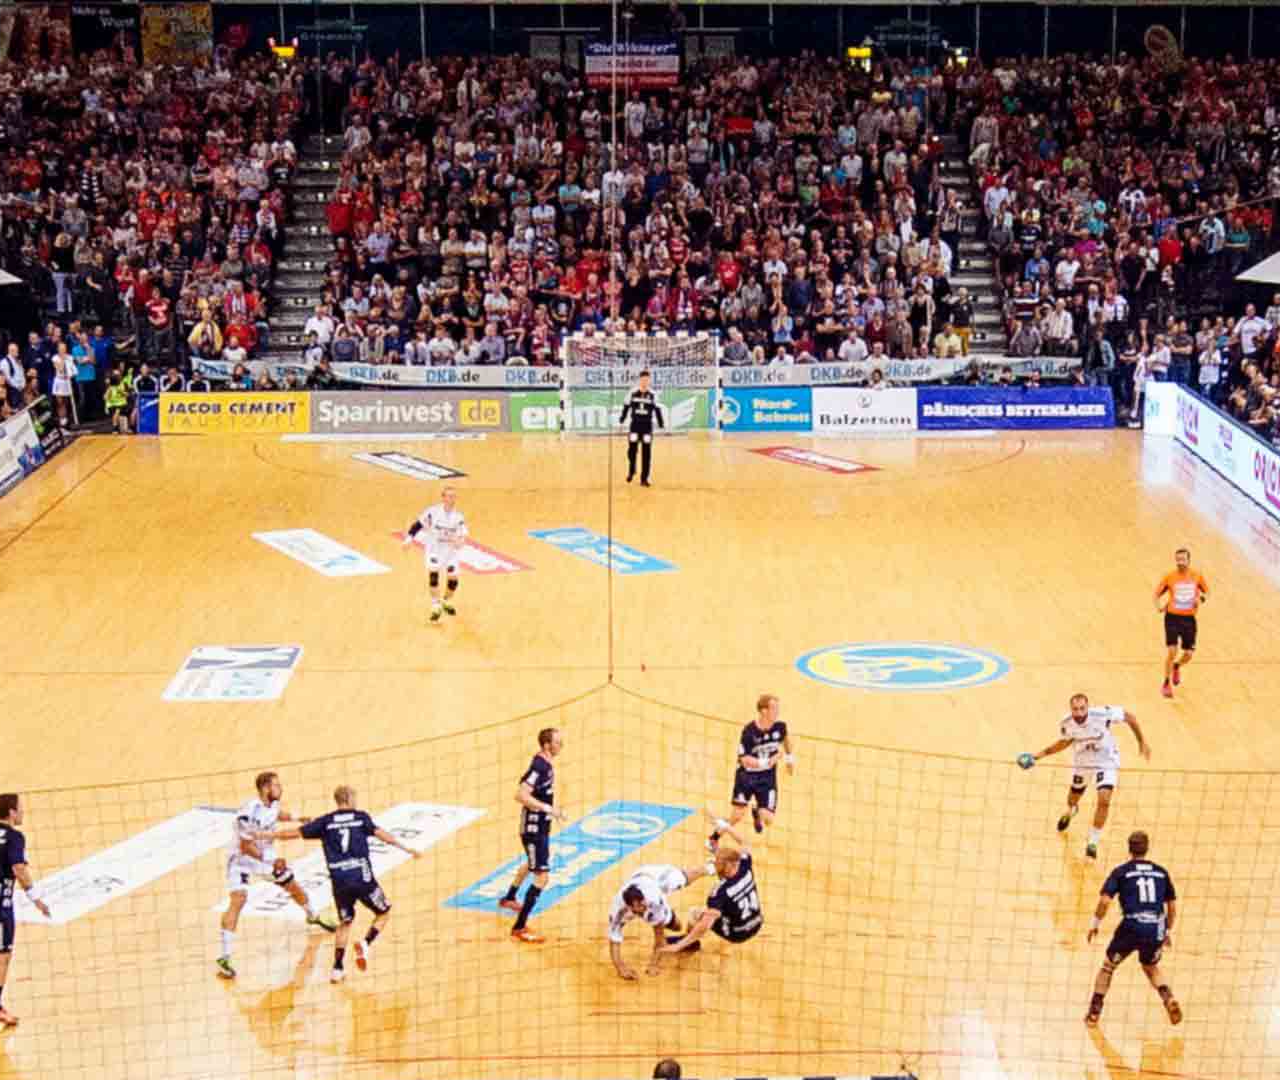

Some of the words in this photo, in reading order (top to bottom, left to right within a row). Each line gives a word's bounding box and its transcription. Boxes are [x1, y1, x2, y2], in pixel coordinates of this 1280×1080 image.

[425, 369, 481, 384] DKB.de
[504, 369, 560, 384] DKB.de
[730, 368, 785, 384] DKB.de
[810, 365, 865, 382] DKB.de
[167, 402, 221, 414] JACOB
[228, 402, 296, 414] CEMENT
[318, 399, 453, 430] Sparinvest
[922, 401, 1004, 418] DÄNISCHES
[1006, 402, 1106, 418] BETTENLAGER
[818, 412, 913, 427] Balzersen
[337, 828, 353, 854] 7
[1135, 875, 1158, 905] 11
